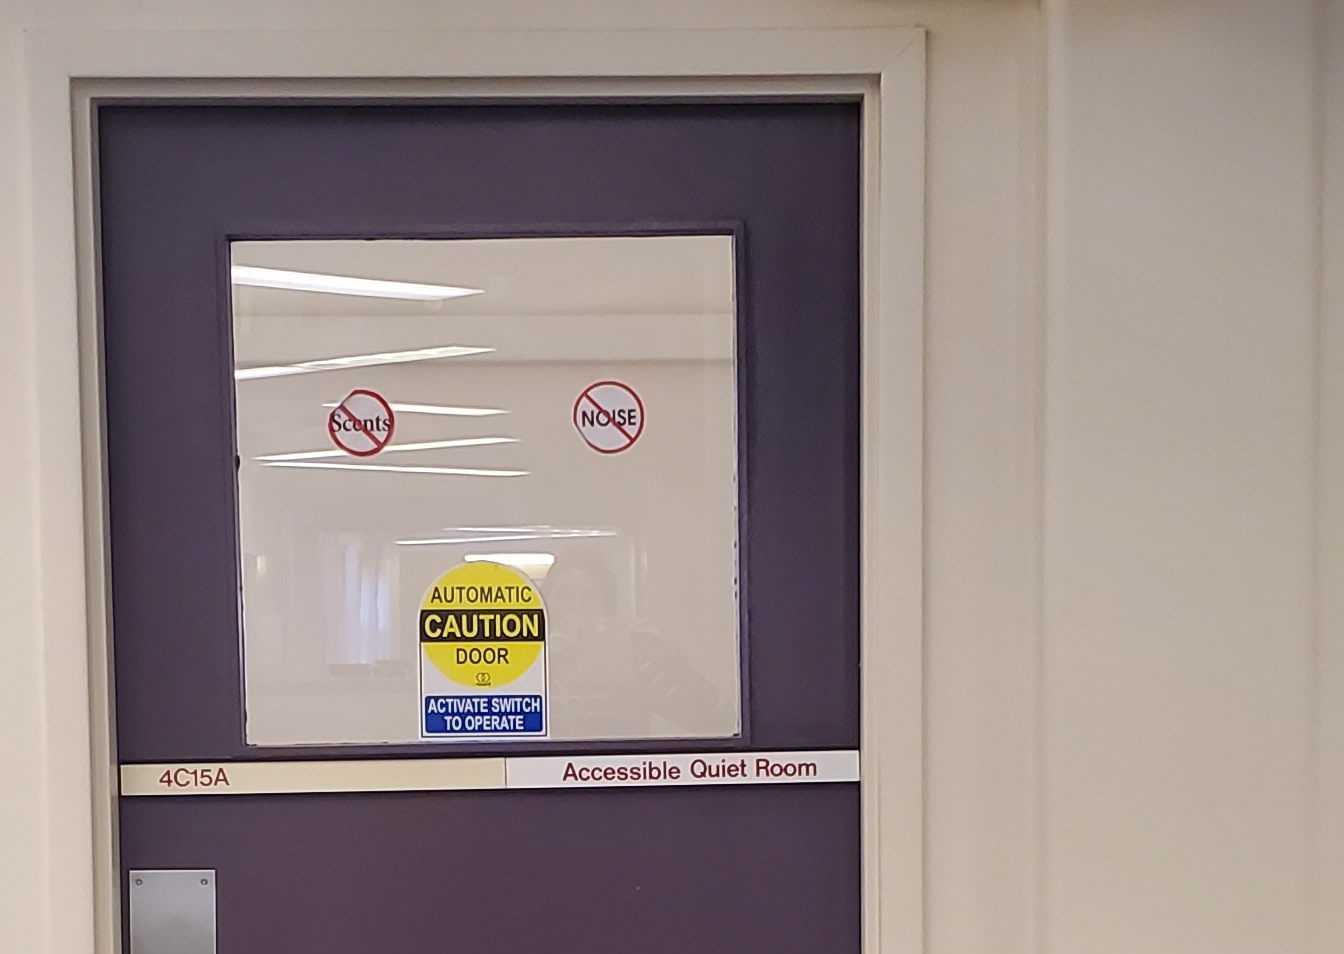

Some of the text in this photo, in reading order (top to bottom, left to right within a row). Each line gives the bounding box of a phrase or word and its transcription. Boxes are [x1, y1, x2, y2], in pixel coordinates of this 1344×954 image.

[581, 408, 637, 428] NOISE
[430, 586, 532, 604] AUTOMATIC
[424, 614, 539, 638] CAUTION
[456, 647, 509, 665] DOOR
[428, 697, 540, 714] ACTIVATE SWITCH
[444, 715, 524, 731] TO OPERATE
[159, 767, 230, 787] 4C15A
[563, 758, 817, 781] Accessible Quiet Room
